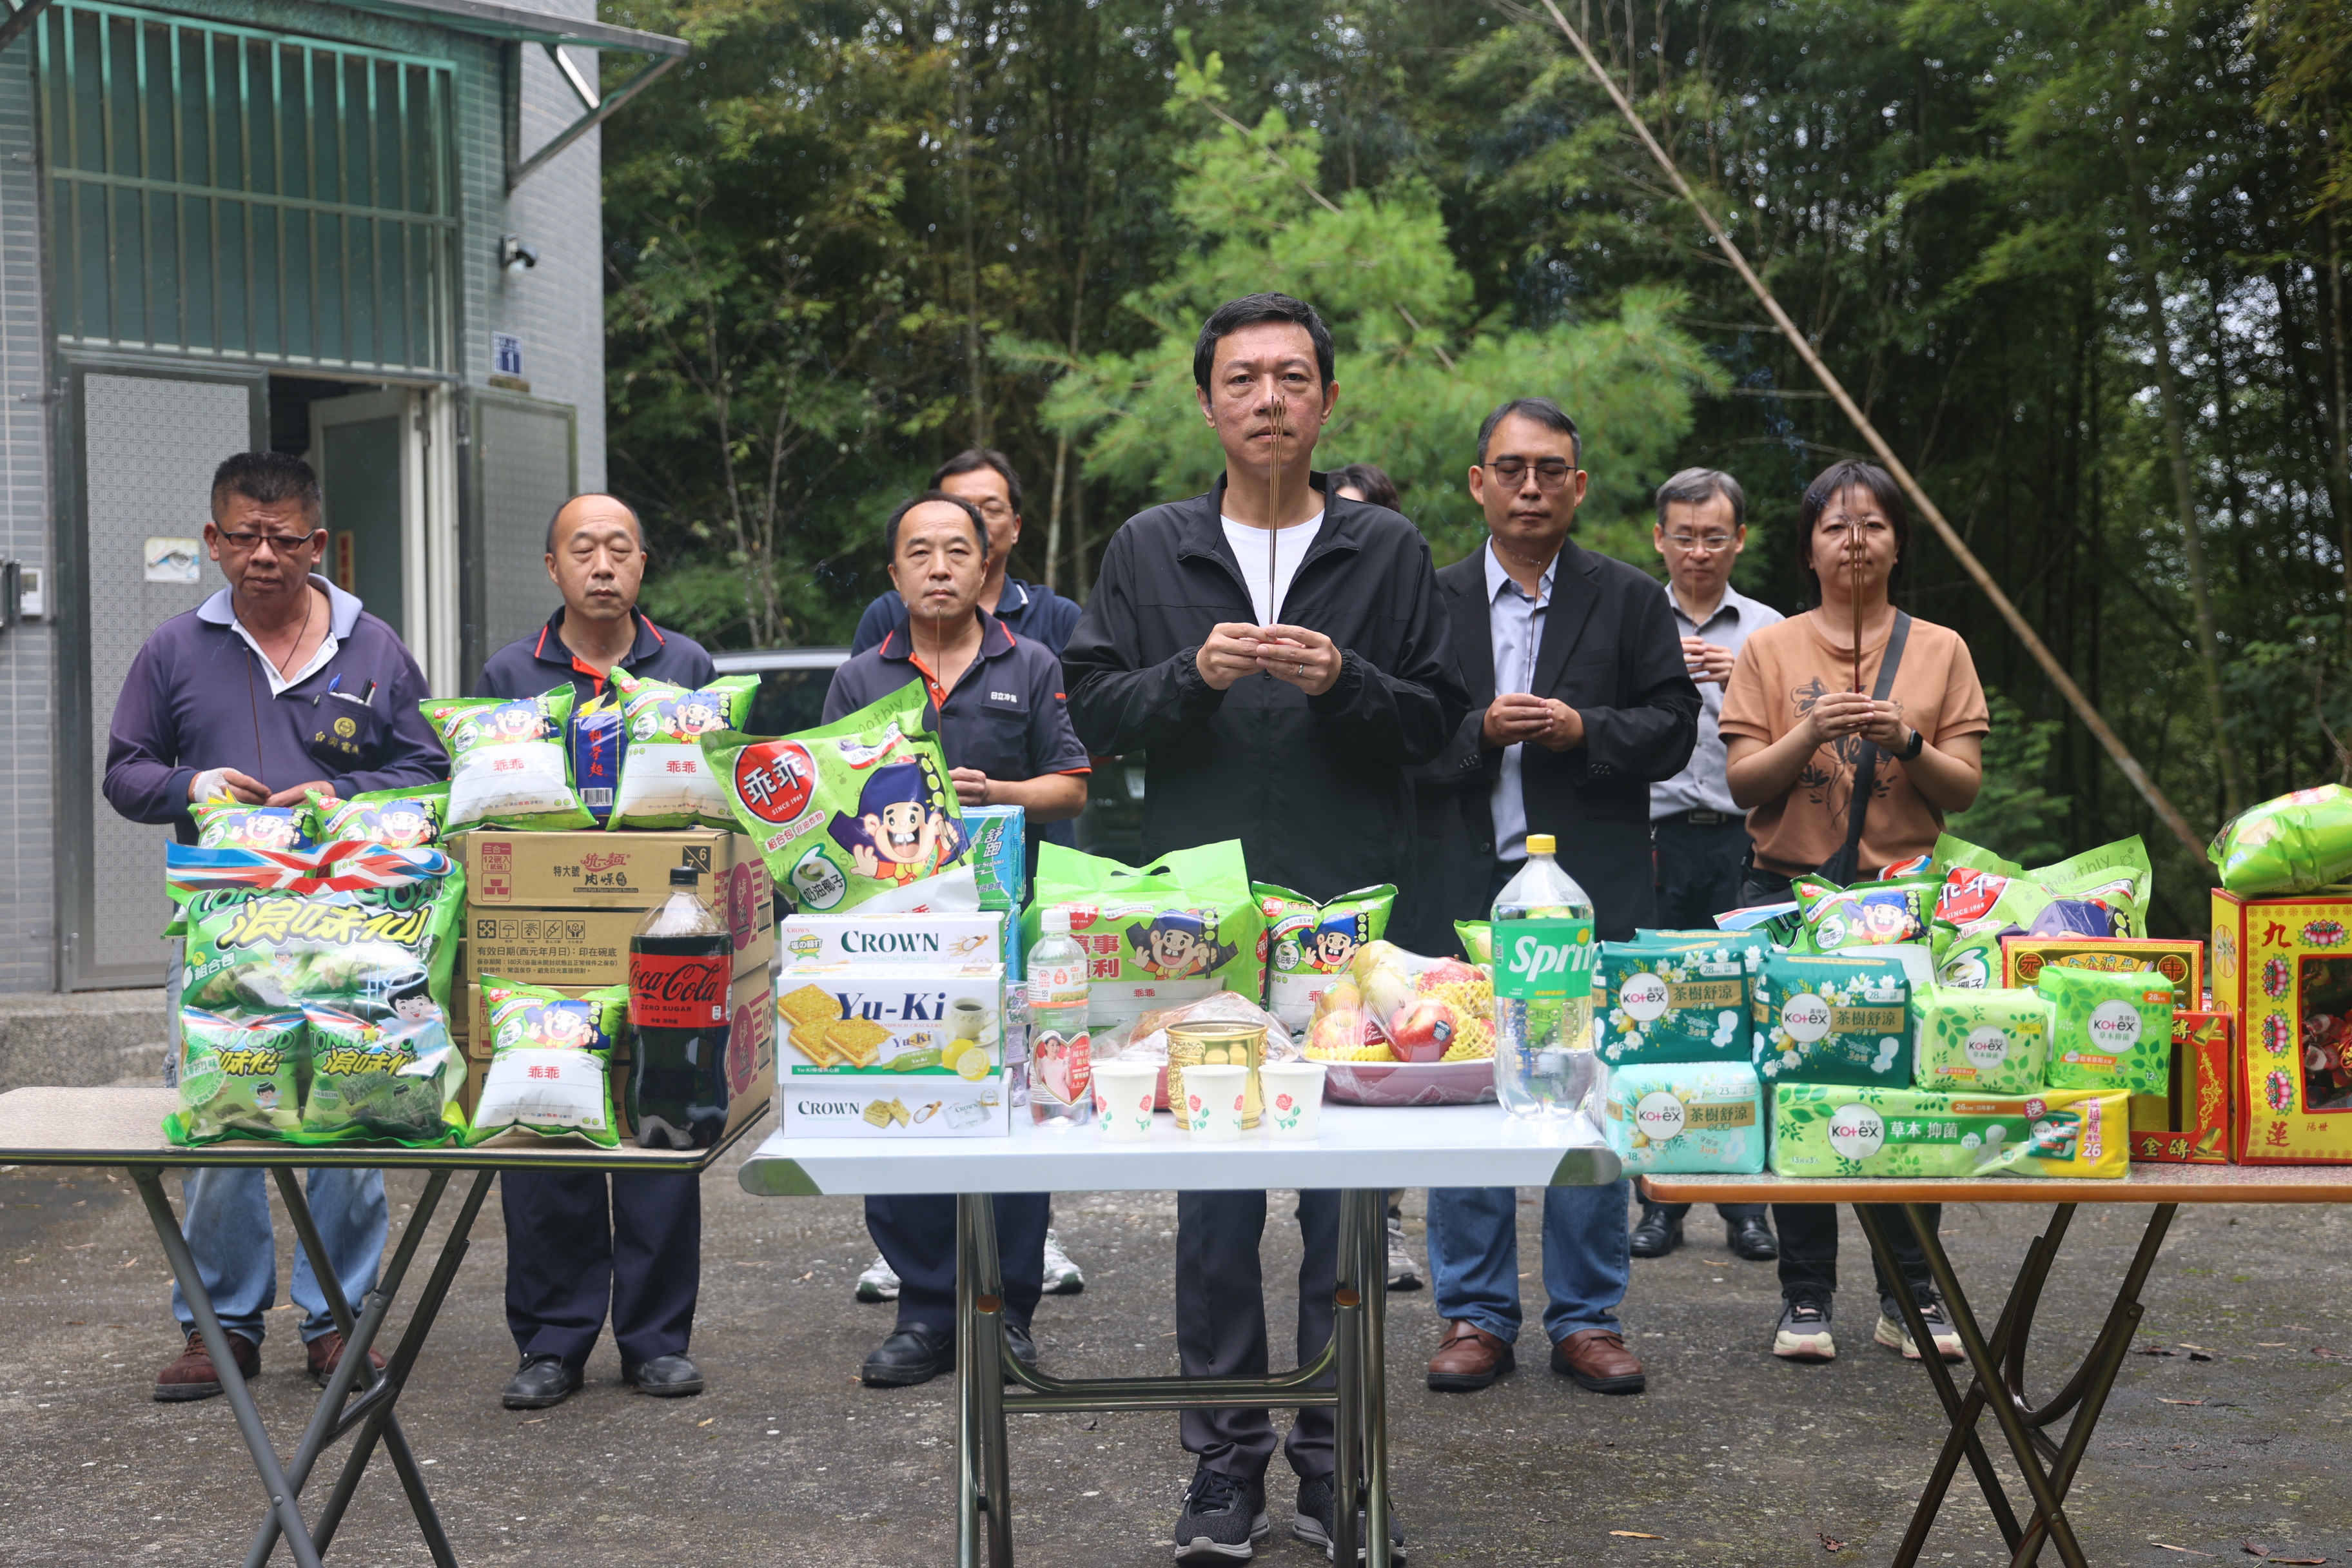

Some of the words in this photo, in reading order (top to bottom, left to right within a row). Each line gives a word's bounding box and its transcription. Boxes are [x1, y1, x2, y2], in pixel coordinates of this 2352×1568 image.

[507, 351, 514, 372] 1
[990, 691, 1017, 703] 日立冷氣
[493, 758, 524, 772] 乖乖
[666, 760, 697, 774] 乖乖
[743, 750, 807, 806] 乖乖
[772, 799, 790, 816] SINCE
[789, 793, 803, 807] 1968
[795, 812, 823, 834] 非油炸物
[765, 829, 795, 850] 組合包
[484, 845, 509, 854] 三合一
[700, 848, 707, 860] 6
[484, 855, 511, 864] 12碗入
[553, 865, 580, 877] 特大號
[803, 876, 844, 903] 奶油椰子
[1263, 901, 1282, 911] 乖乖
[1946, 908, 1968, 919] SINCE
[1969, 902, 1984, 914] 1968
[220, 899, 429, 944] 浪味仙
[841, 930, 939, 953] CROWN
[2262, 920, 2292, 948] 九
[1509, 928, 1593, 982] Sprit
[194, 953, 235, 980] 組合包
[1084, 959, 1119, 978] 利
[2021, 955, 2041, 975] 元
[2162, 958, 2182, 981] 中
[629, 961, 723, 1002] Coca-Cola
[1133, 988, 1155, 997] 乖乖
[1674, 985, 1733, 1001] 茶樹舒涼
[834, 992, 947, 1021] Yu-Ki
[1836, 1010, 1896, 1026] 茶樹舒涼
[245, 1029, 295, 1049] GOD
[892, 1031, 932, 1048] Yu-Ki
[2099, 1032, 2130, 1041] 草本抑菌
[528, 1066, 560, 1079] 乖乖
[798, 1101, 859, 1115] CROWN
[1689, 1106, 1747, 1122] 茶樹舒涼
[2026, 1101, 2044, 1117] 送
[2266, 1121, 2290, 1148] 蓮
[2082, 1142, 2102, 1157] 26
